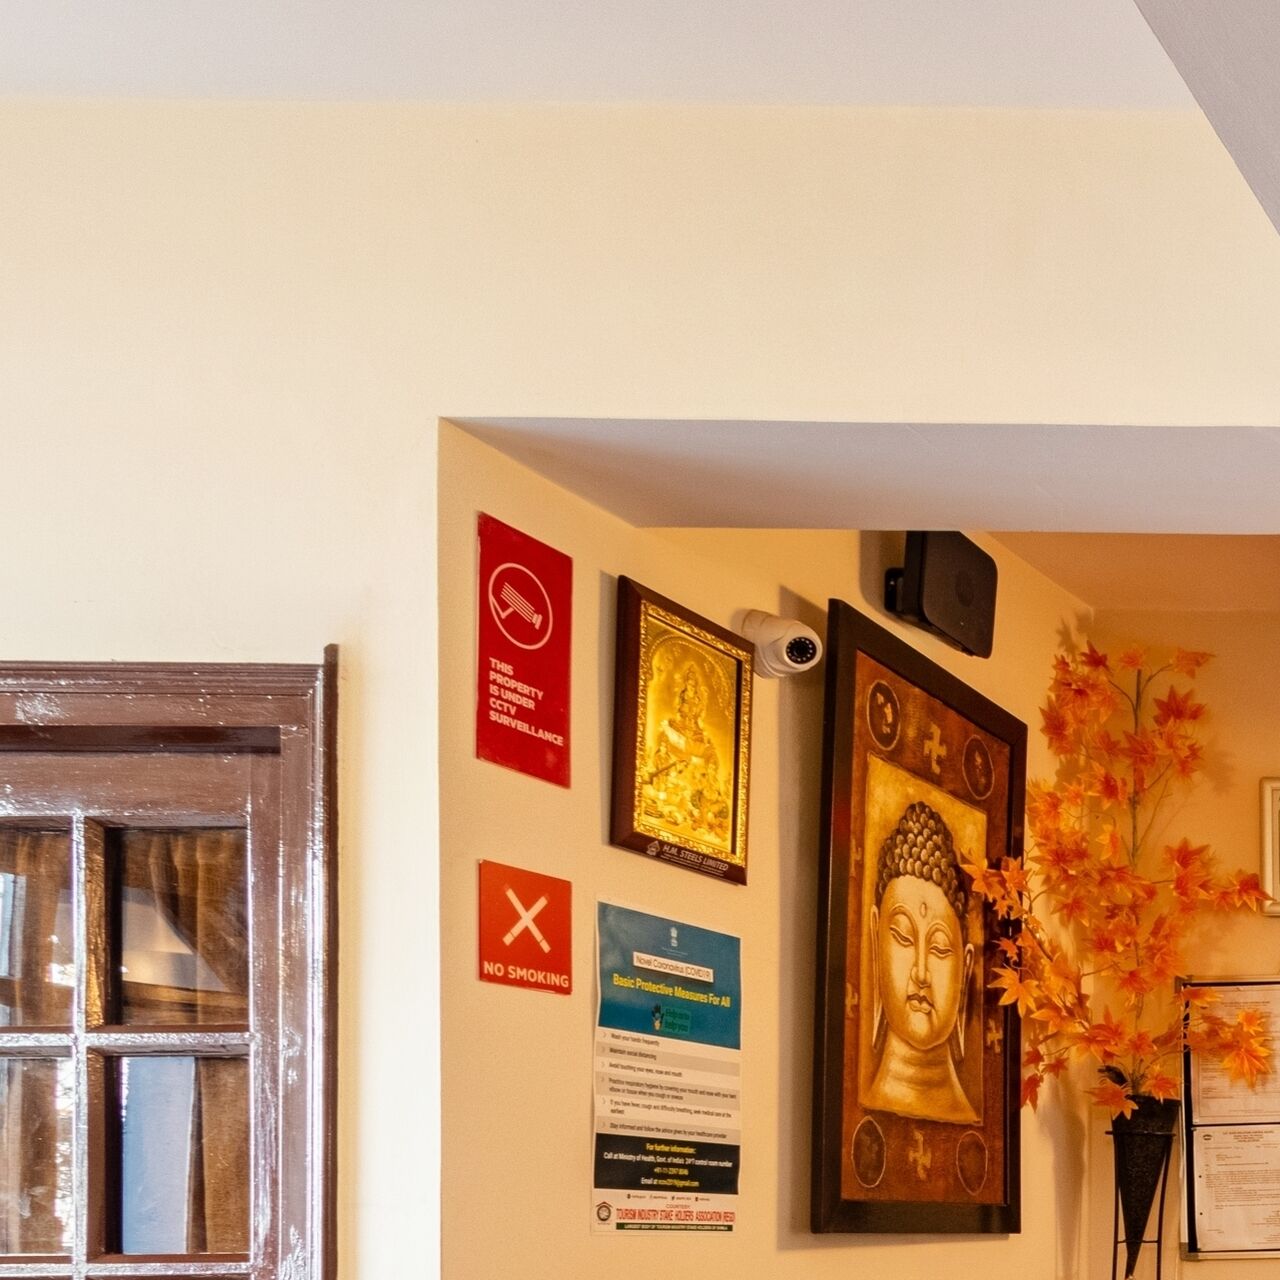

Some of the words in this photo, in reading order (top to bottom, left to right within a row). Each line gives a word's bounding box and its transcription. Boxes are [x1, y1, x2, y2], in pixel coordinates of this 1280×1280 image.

[489, 657, 514, 676] THIS
[489, 671, 544, 700] PROPERTY
[489, 684, 500, 696] IS
[500, 688, 535, 711] UNDER
[489, 698, 517, 716] CCTV
[489, 711, 564, 746] SURVEILLANCE
[679, 850, 704, 864] STEELS
[703, 857, 729, 871] LIMITED
[483, 961, 504, 977] NO
[507, 965, 569, 988] SMOKING
[613, 973, 636, 989] Basic
[637, 977, 675, 996] Protective
[674, 986, 708, 1003] Measures
[709, 993, 720, 1005] For
[721, 996, 732, 1007] All
